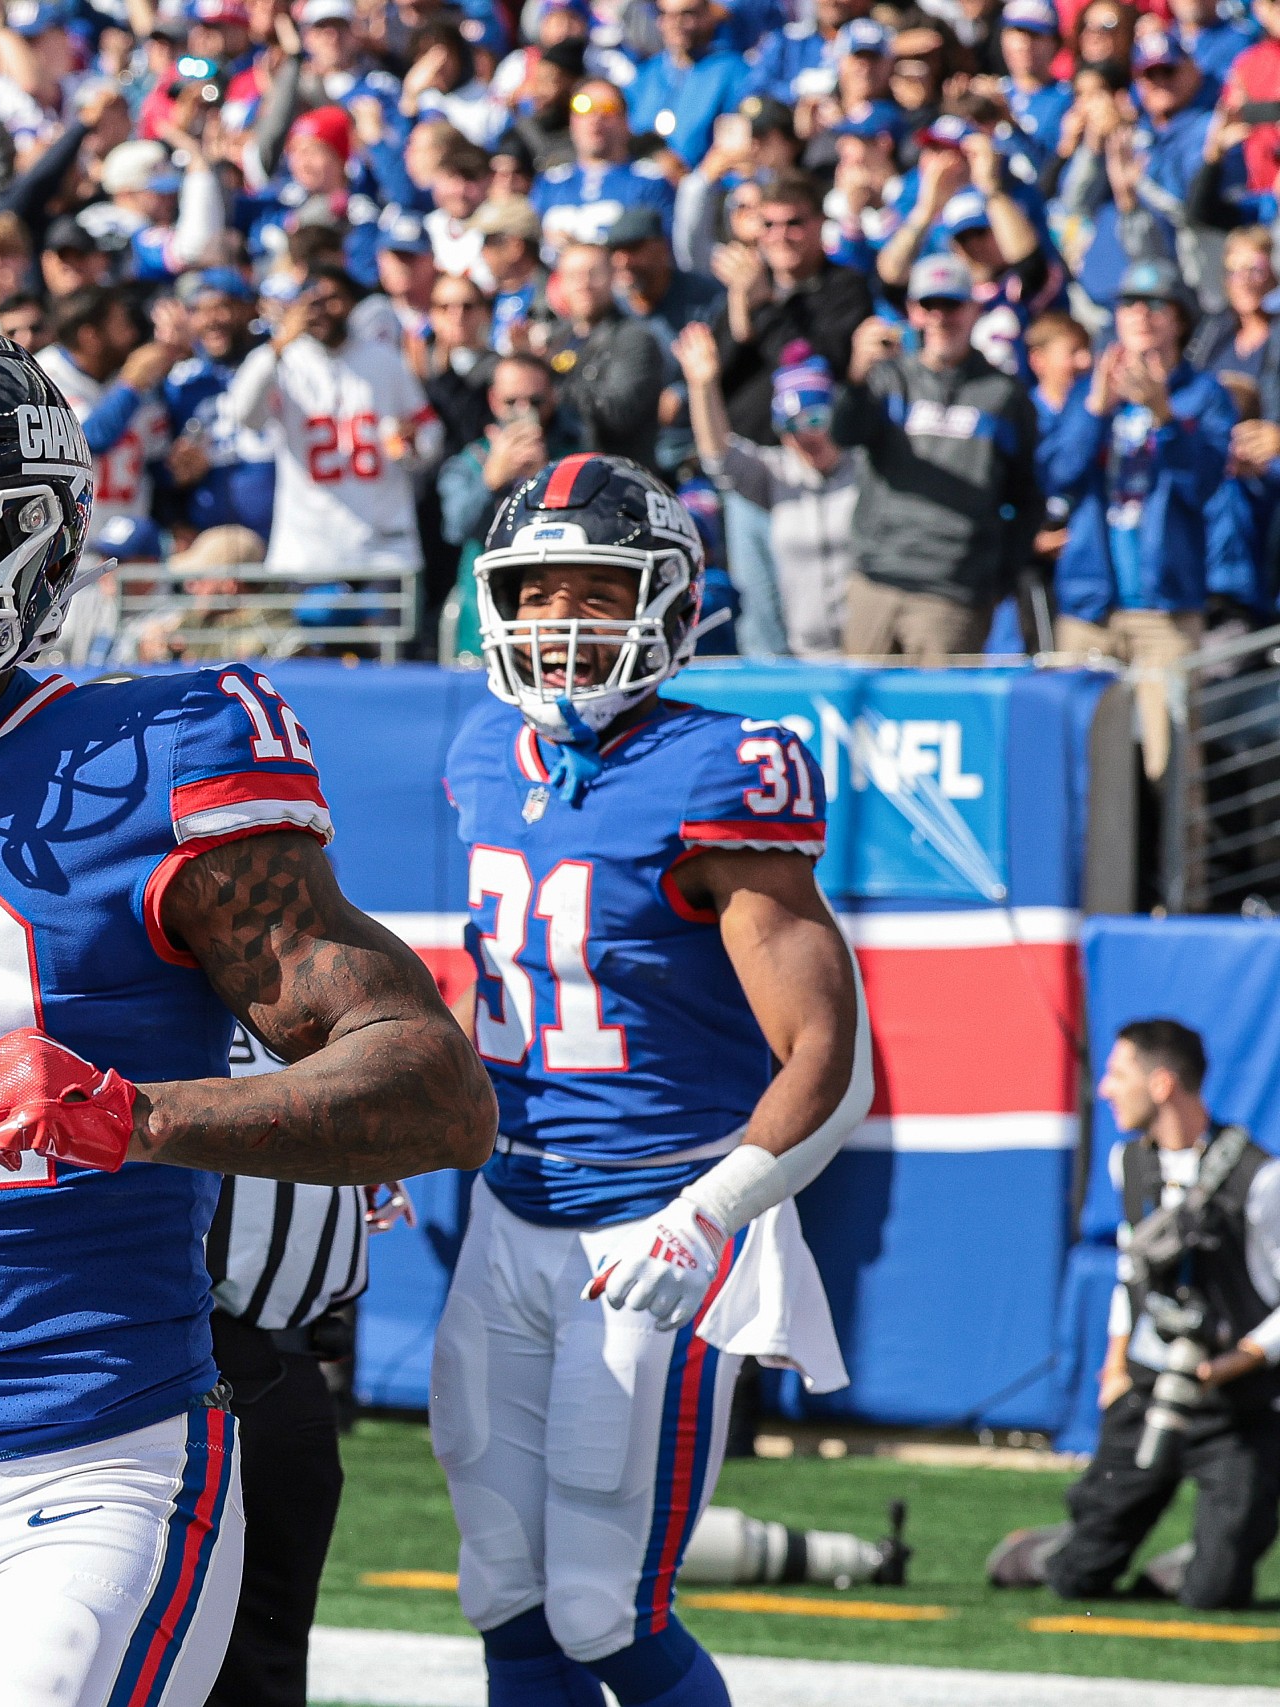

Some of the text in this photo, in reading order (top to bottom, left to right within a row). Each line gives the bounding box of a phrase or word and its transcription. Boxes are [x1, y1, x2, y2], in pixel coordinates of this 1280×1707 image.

[217, 672, 317, 765] 12
[737, 737, 815, 818] 31
[468, 843, 629, 1073] 31
